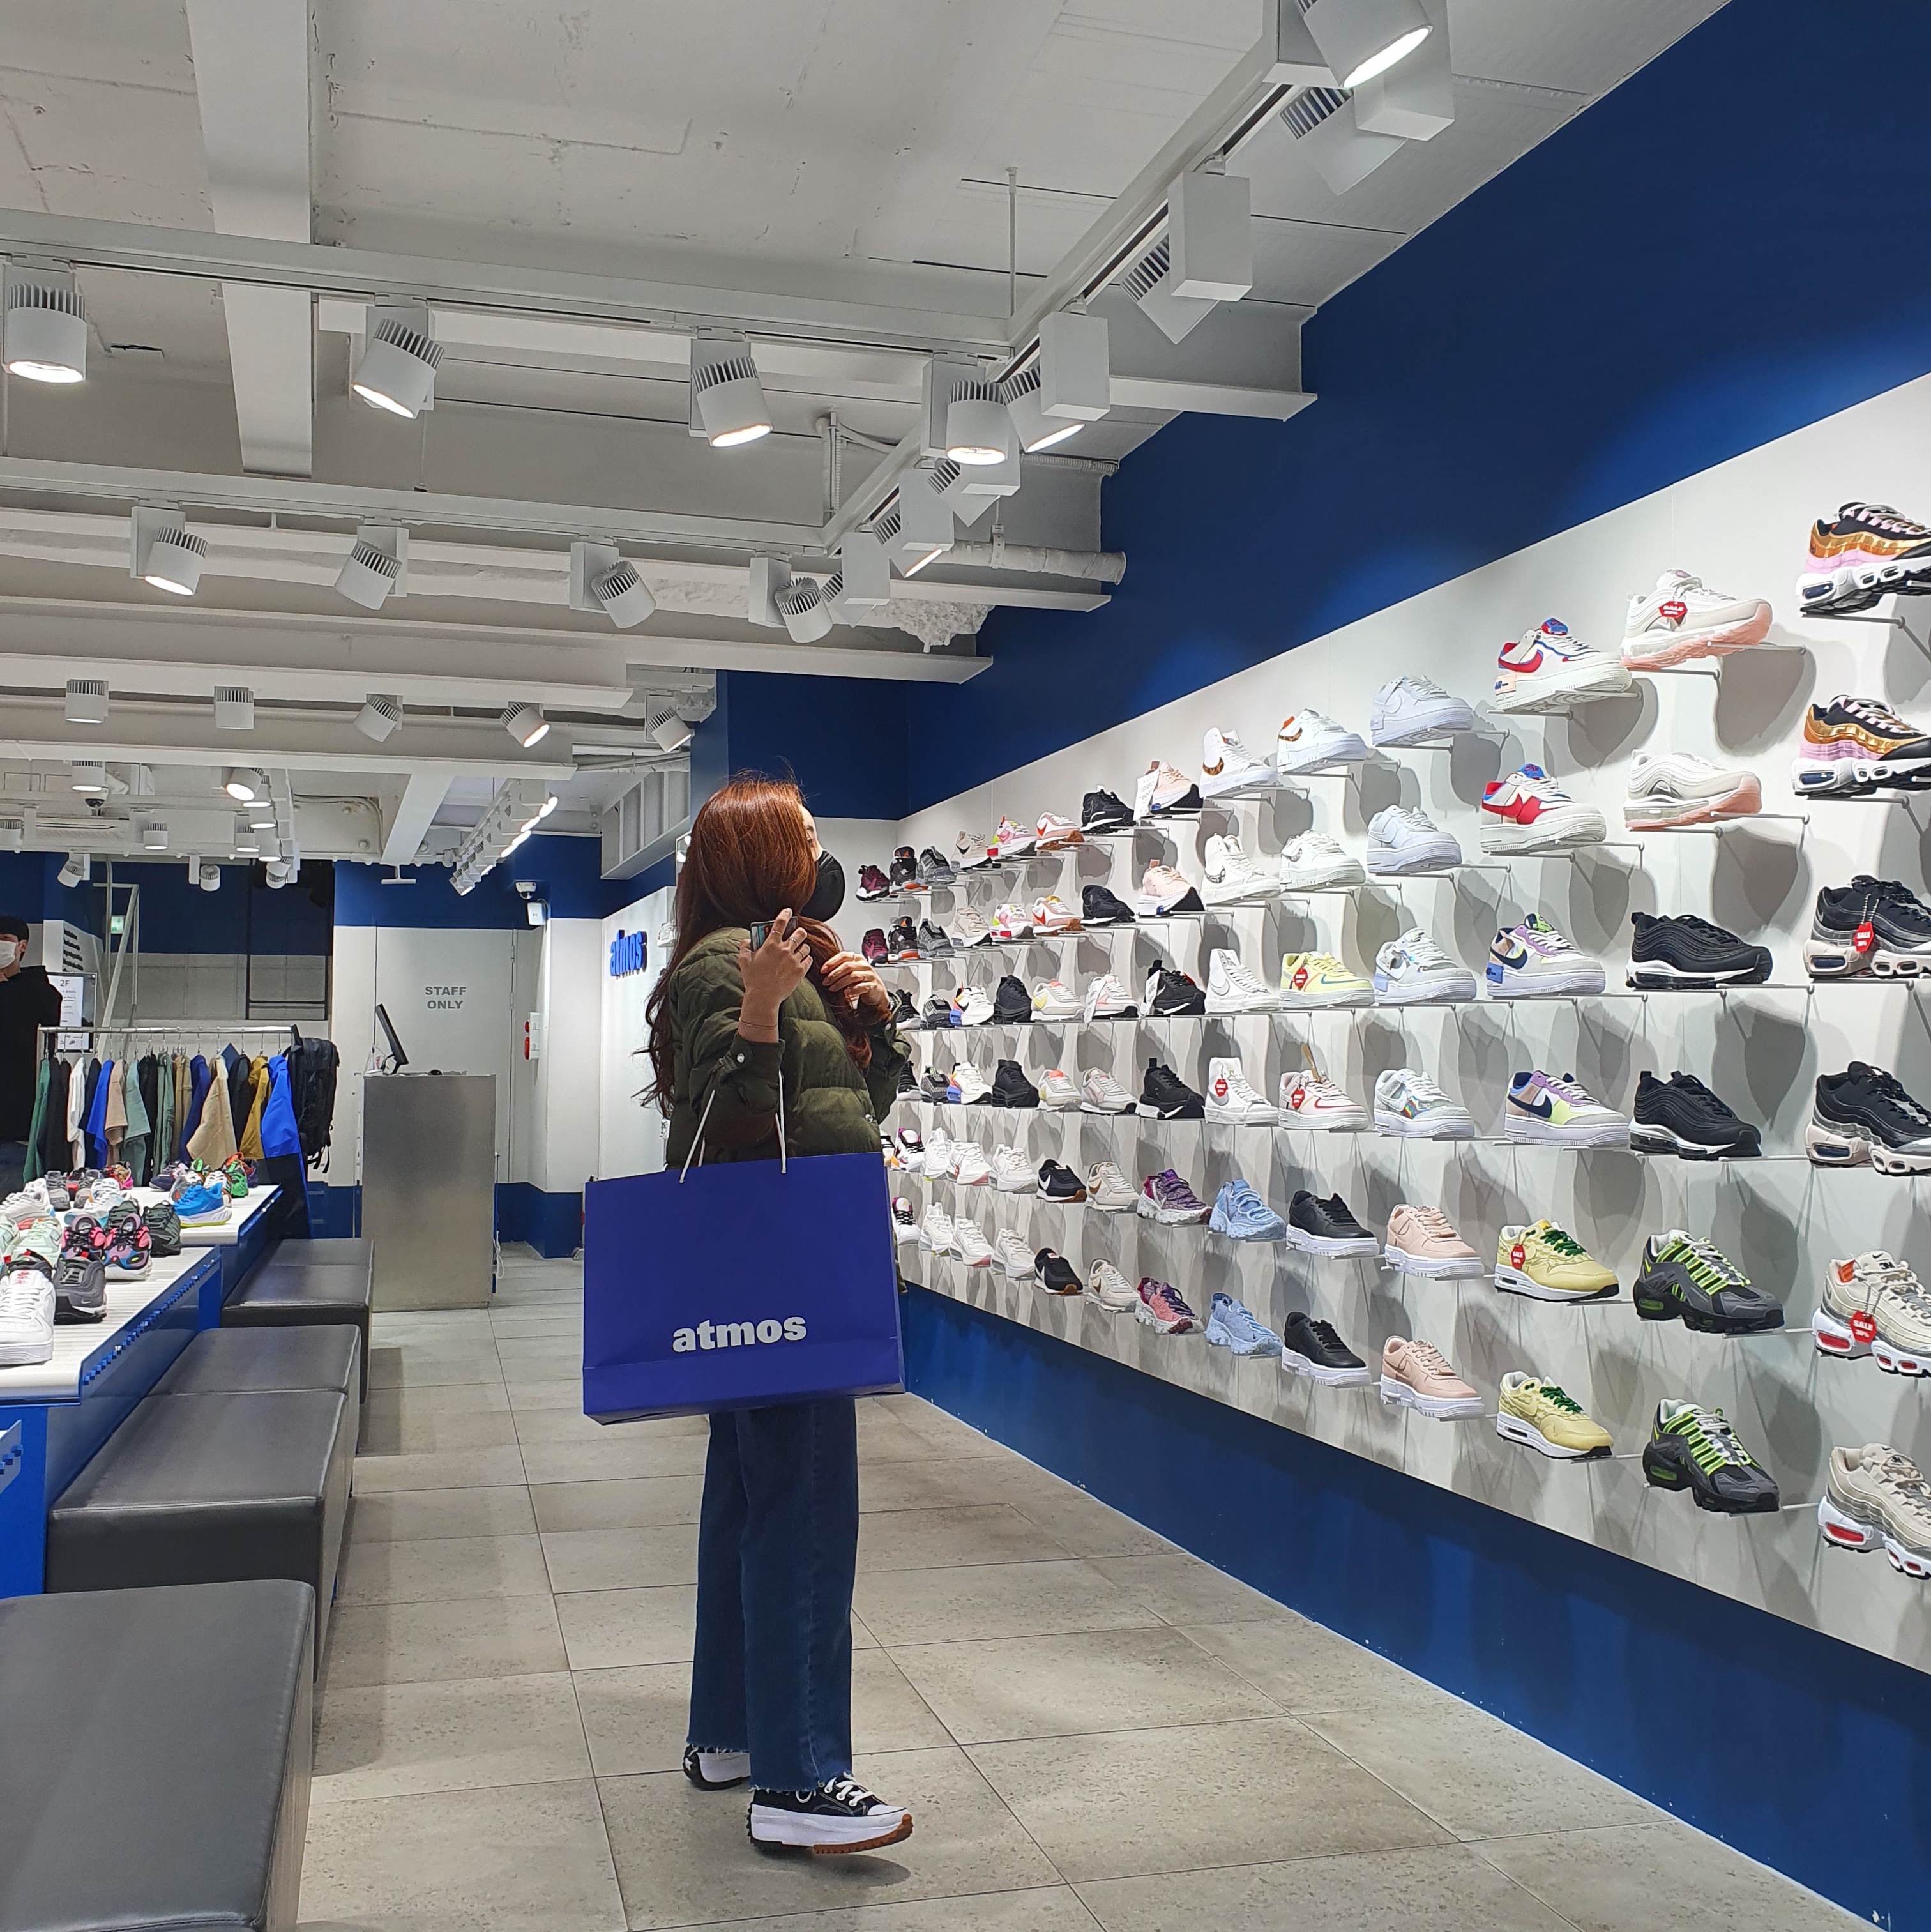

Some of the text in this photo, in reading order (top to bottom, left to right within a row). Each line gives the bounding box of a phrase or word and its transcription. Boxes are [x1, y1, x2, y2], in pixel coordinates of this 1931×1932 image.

[610, 929, 644, 977] atmos
[59, 979, 70, 987] 2F
[425, 986, 467, 996] STAFF
[427, 1000, 464, 1009] ONLY
[1879, 1261, 1895, 1270] 3M
[1853, 1320, 1874, 1332] SALE
[672, 1316, 807, 1353] atmos
[1855, 1329, 1870, 1338] 30%
